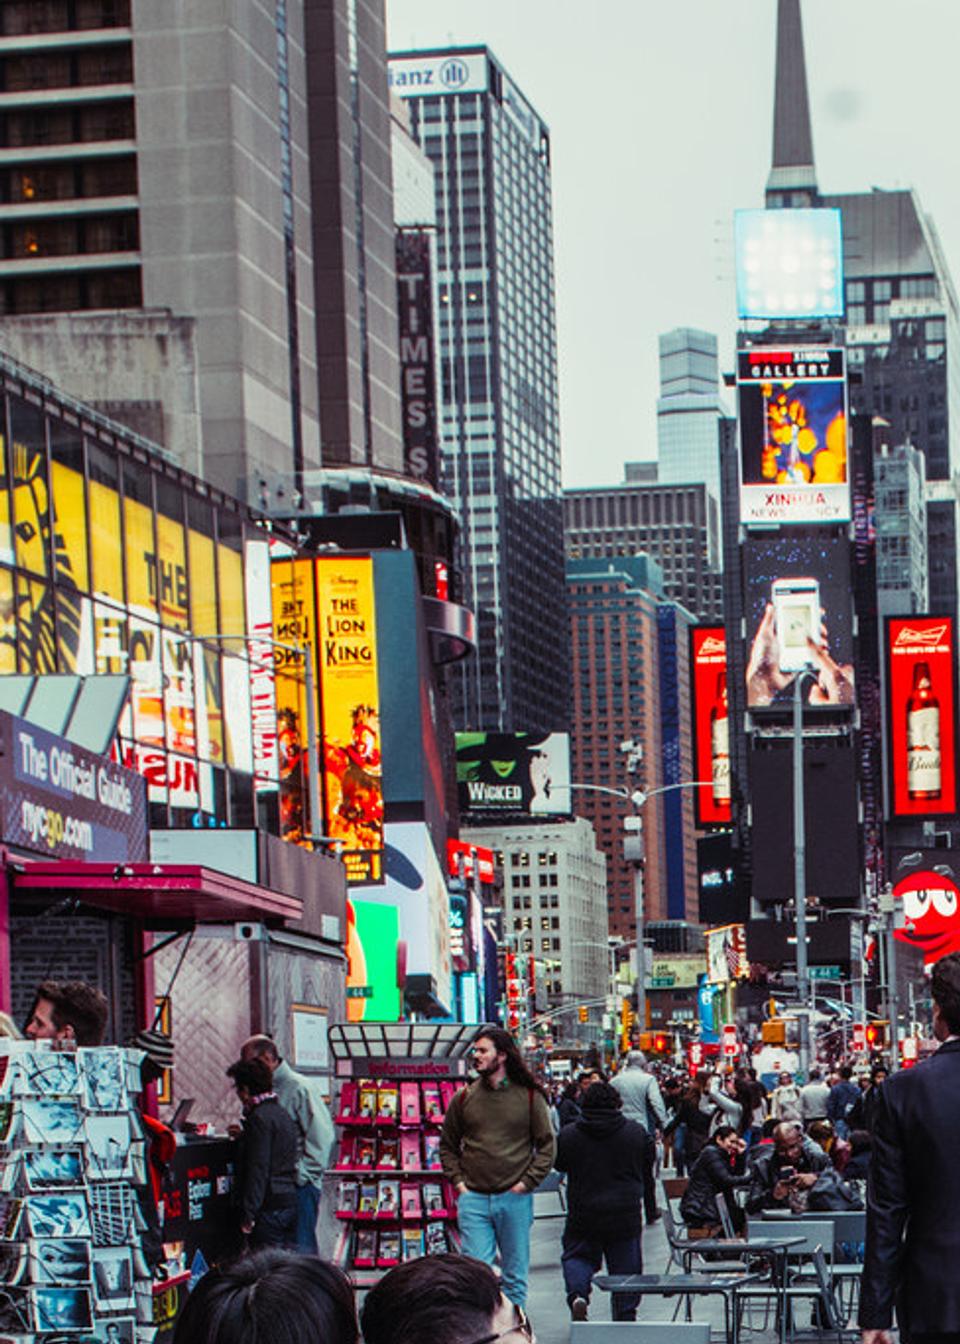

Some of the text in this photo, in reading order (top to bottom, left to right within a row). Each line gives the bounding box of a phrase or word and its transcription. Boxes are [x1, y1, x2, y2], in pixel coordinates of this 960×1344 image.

[398, 273, 428, 428] TIMES
[751, 364, 830, 377] GALLERY
[331, 599, 358, 612] THE
[327, 615, 366, 638] LION
[325, 640, 372, 667] KING
[19, 732, 132, 815] The Official Guide
[22, 801, 94, 852] nycgo.com
[819, 969, 831, 977] 44
